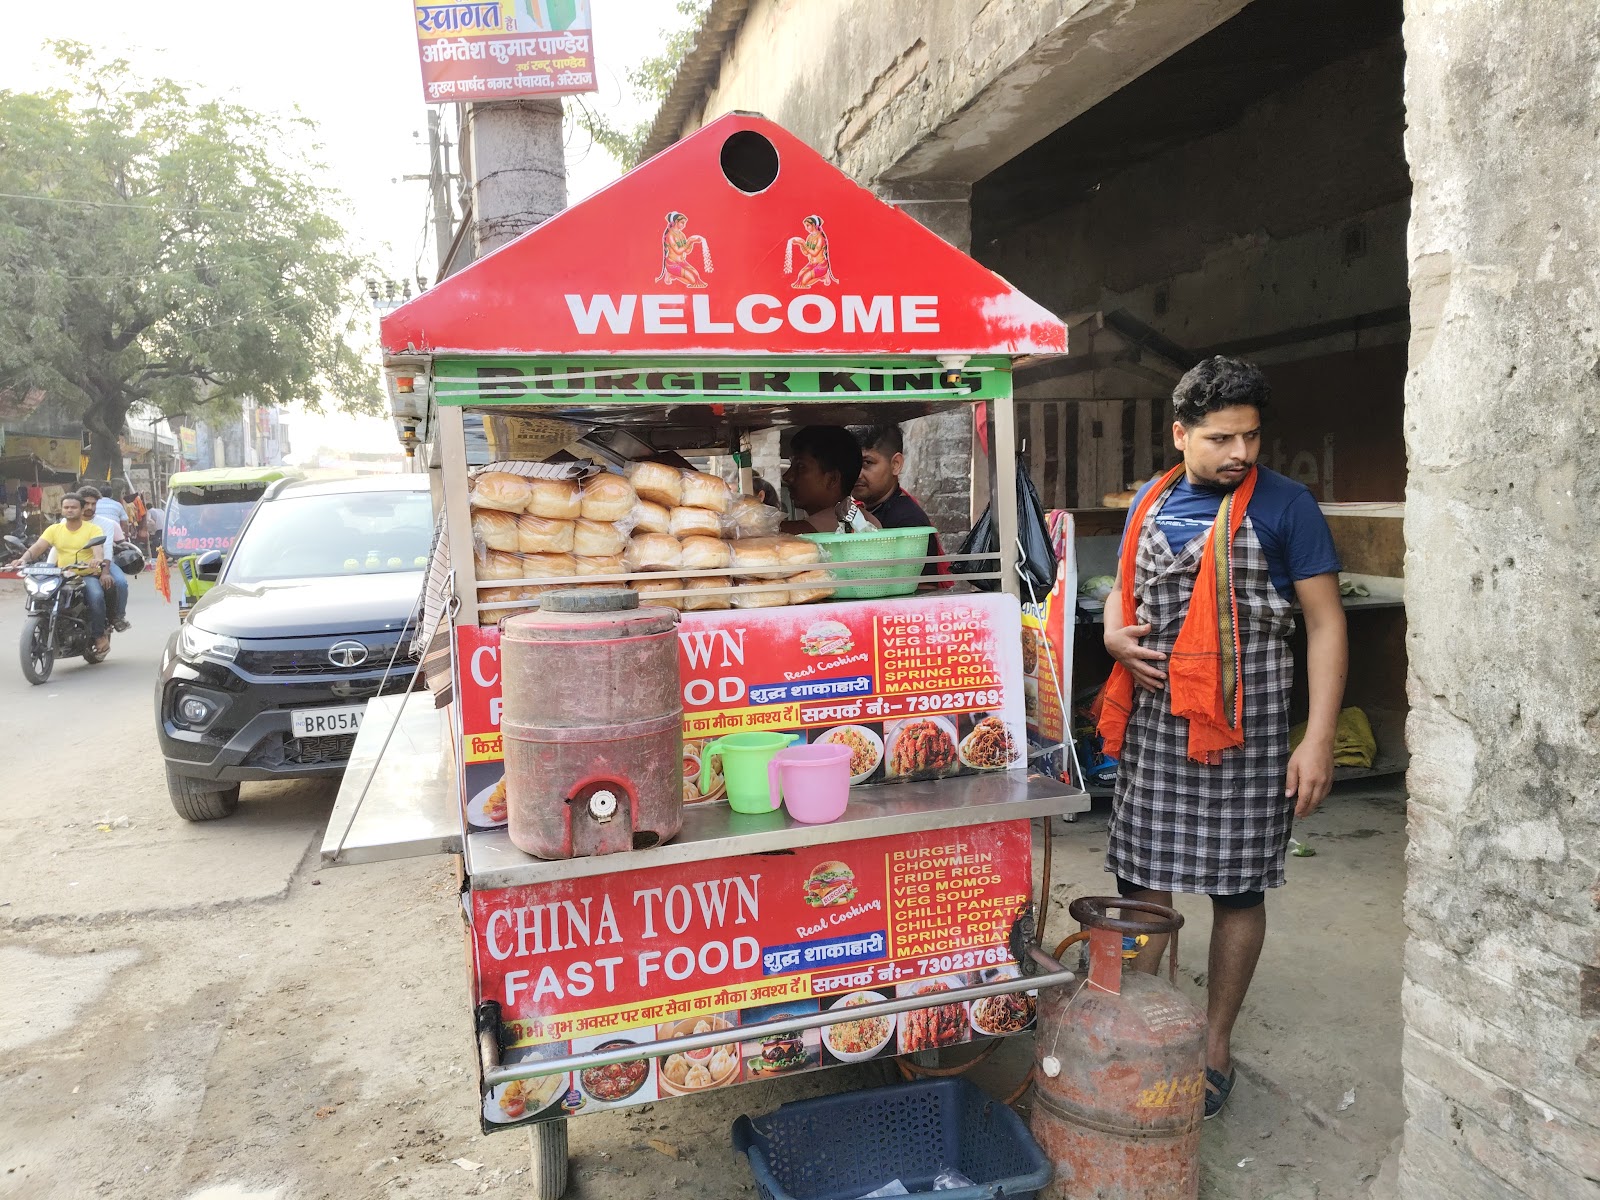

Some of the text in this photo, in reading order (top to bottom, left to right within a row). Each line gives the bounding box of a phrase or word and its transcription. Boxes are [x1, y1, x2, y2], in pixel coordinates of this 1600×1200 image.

[417, 2, 500, 31] स्वागत
[422, 32, 589, 64] अमितेश कुमार पाण्डेय
[428, 70, 592, 98] मुख्य पार्षद नगर पंचायत, अरेराज
[564, 293, 941, 334] WELCOME
[476, 366, 982, 399] BURGER KING
[168, 524, 190, 536] Mob.
[883, 608, 982, 625] FRIDE RICE
[883, 619, 991, 636] VEG MOMOS
[679, 628, 747, 670] WN
[883, 632, 975, 647] VEG SOUP
[883, 646, 942, 658] CHILLI
[784, 652, 869, 681] Real Cooking
[884, 657, 942, 670] CHILLI
[885, 667, 951, 681] SPRING
[684, 677, 746, 706] OD
[750, 675, 870, 703] शुद्ध शाकाहारी
[886, 675, 1002, 693] MANCHURIAN
[694, 717, 710, 731] का
[712, 712, 743, 729] मौका
[746, 711, 781, 726] अवश्य
[801, 700, 861, 722] सम्पर्क
[894, 843, 968, 861] BURGER
[894, 852, 992, 873] CHOWMEIN
[894, 864, 993, 885] FRIDE RICE
[894, 875, 1002, 896] VEG MOMOS
[895, 888, 985, 909] VEG SOUP
[895, 894, 1027, 921] CHILLI PANEER
[485, 873, 762, 961] CHINA TOWN
[796, 899, 881, 939] Real Cooking
[896, 916, 952, 933] CHILLI
[896, 919, 1012, 945] SPRING ROLL
[897, 931, 1010, 958] MANCHURIAN
[763, 933, 883, 972] शुद्ध शाकाहारी
[504, 936, 761, 1006] FAST FOOD
[812, 966, 875, 993] सम्पर्क
[527, 1020, 544, 1037] भी
[547, 1019, 573, 1039] शुभ
[576, 1012, 619, 1031] अवसर
[621, 1009, 639, 1024] पर
[641, 1005, 663, 1020] बार
[666, 999, 691, 1016] सेवा
[694, 996, 711, 1010] का
[714, 987, 747, 1006] मौका
[751, 983, 787, 1000] अवश्य
